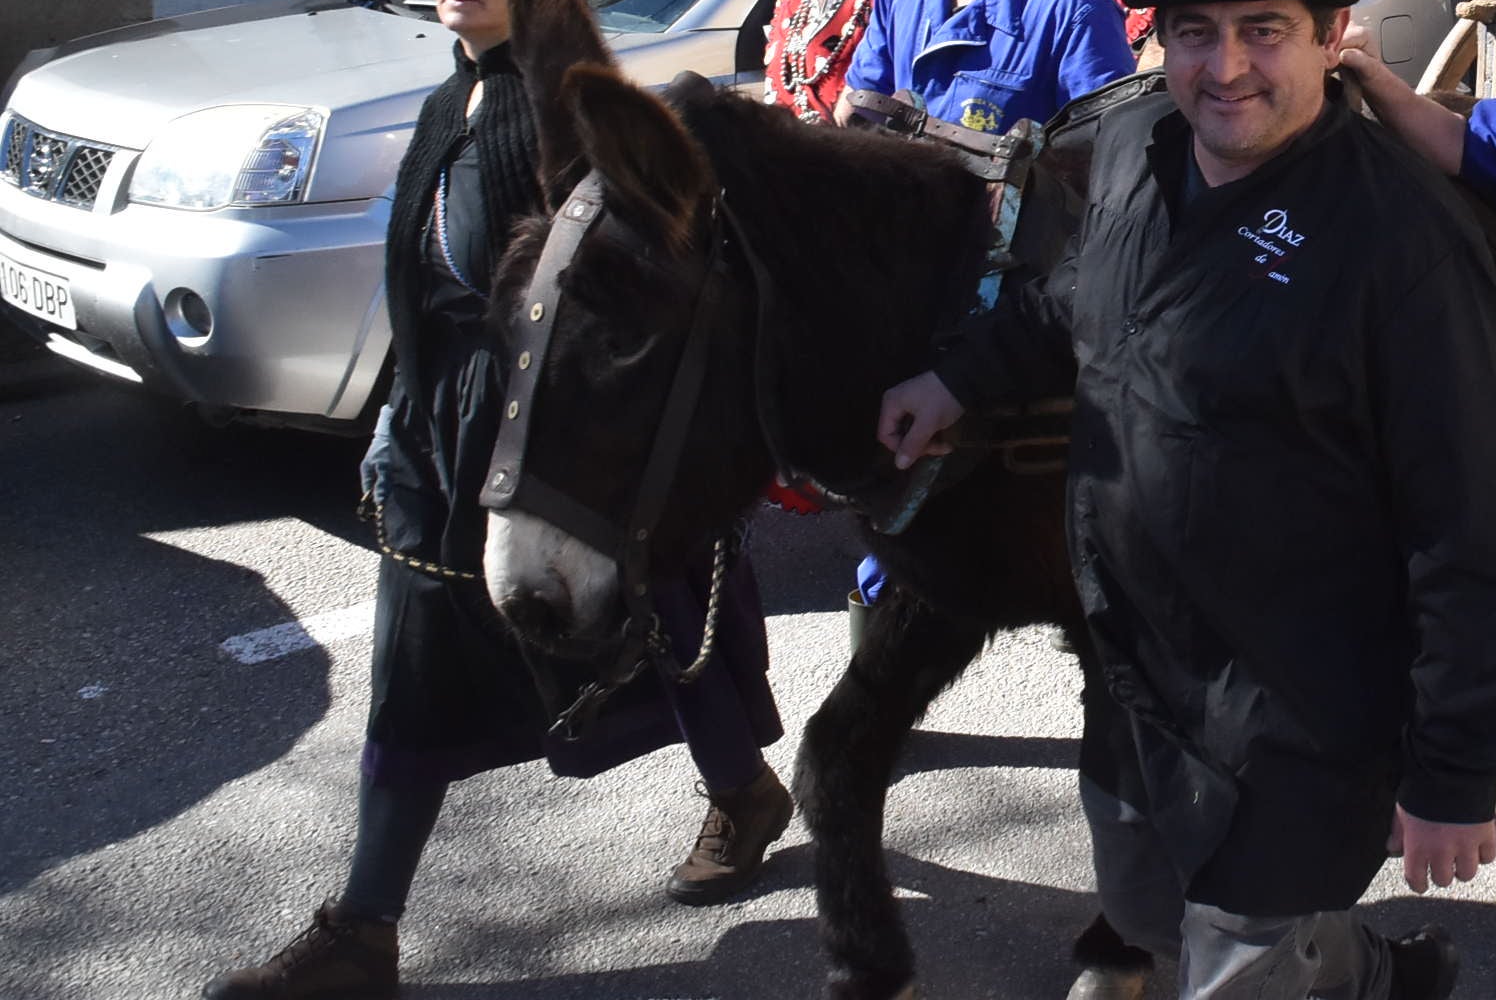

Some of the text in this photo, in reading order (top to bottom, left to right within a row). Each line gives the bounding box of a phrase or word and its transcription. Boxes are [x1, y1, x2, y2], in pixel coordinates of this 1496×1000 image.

[1237, 226, 1286, 257] Cortadores
[1254, 253, 1268, 264] de
[32, 276, 68, 319] DBP
